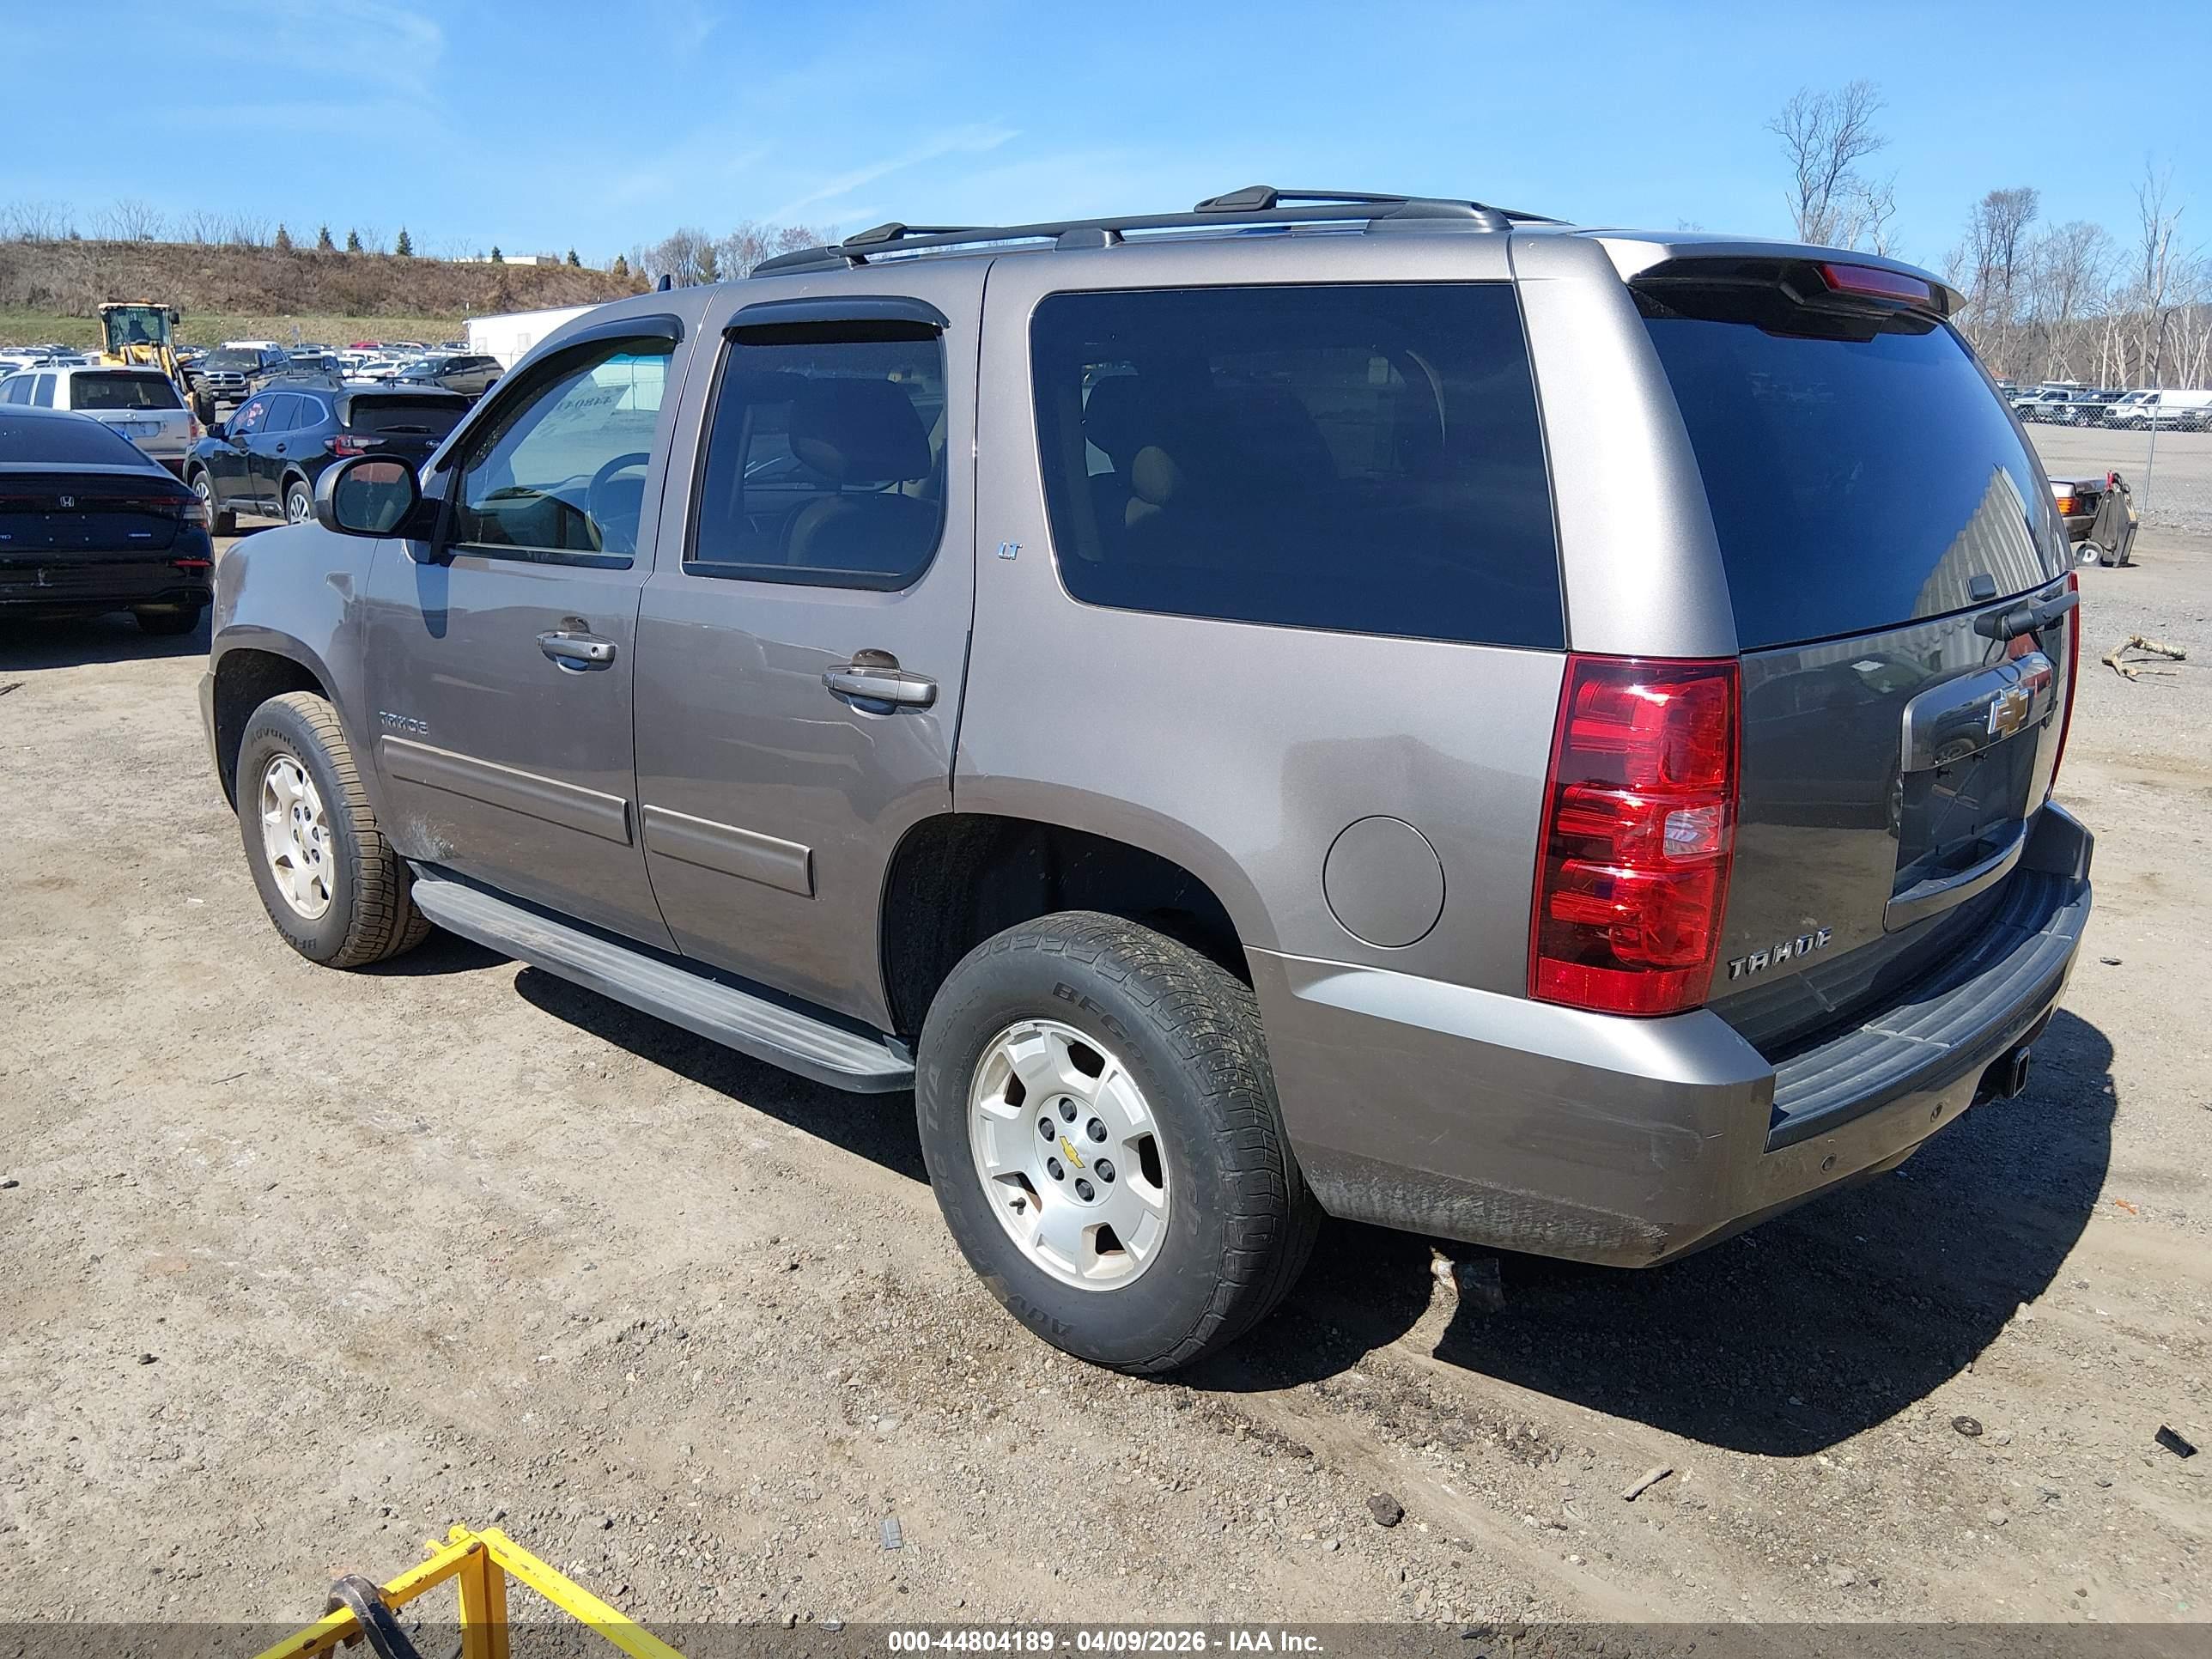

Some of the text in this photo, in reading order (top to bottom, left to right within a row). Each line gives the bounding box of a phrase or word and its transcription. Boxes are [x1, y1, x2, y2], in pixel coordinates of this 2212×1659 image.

[998, 542, 1024, 561] LT
[379, 711, 428, 736] TAHOE
[1728, 927, 1832, 980] TAHOE
